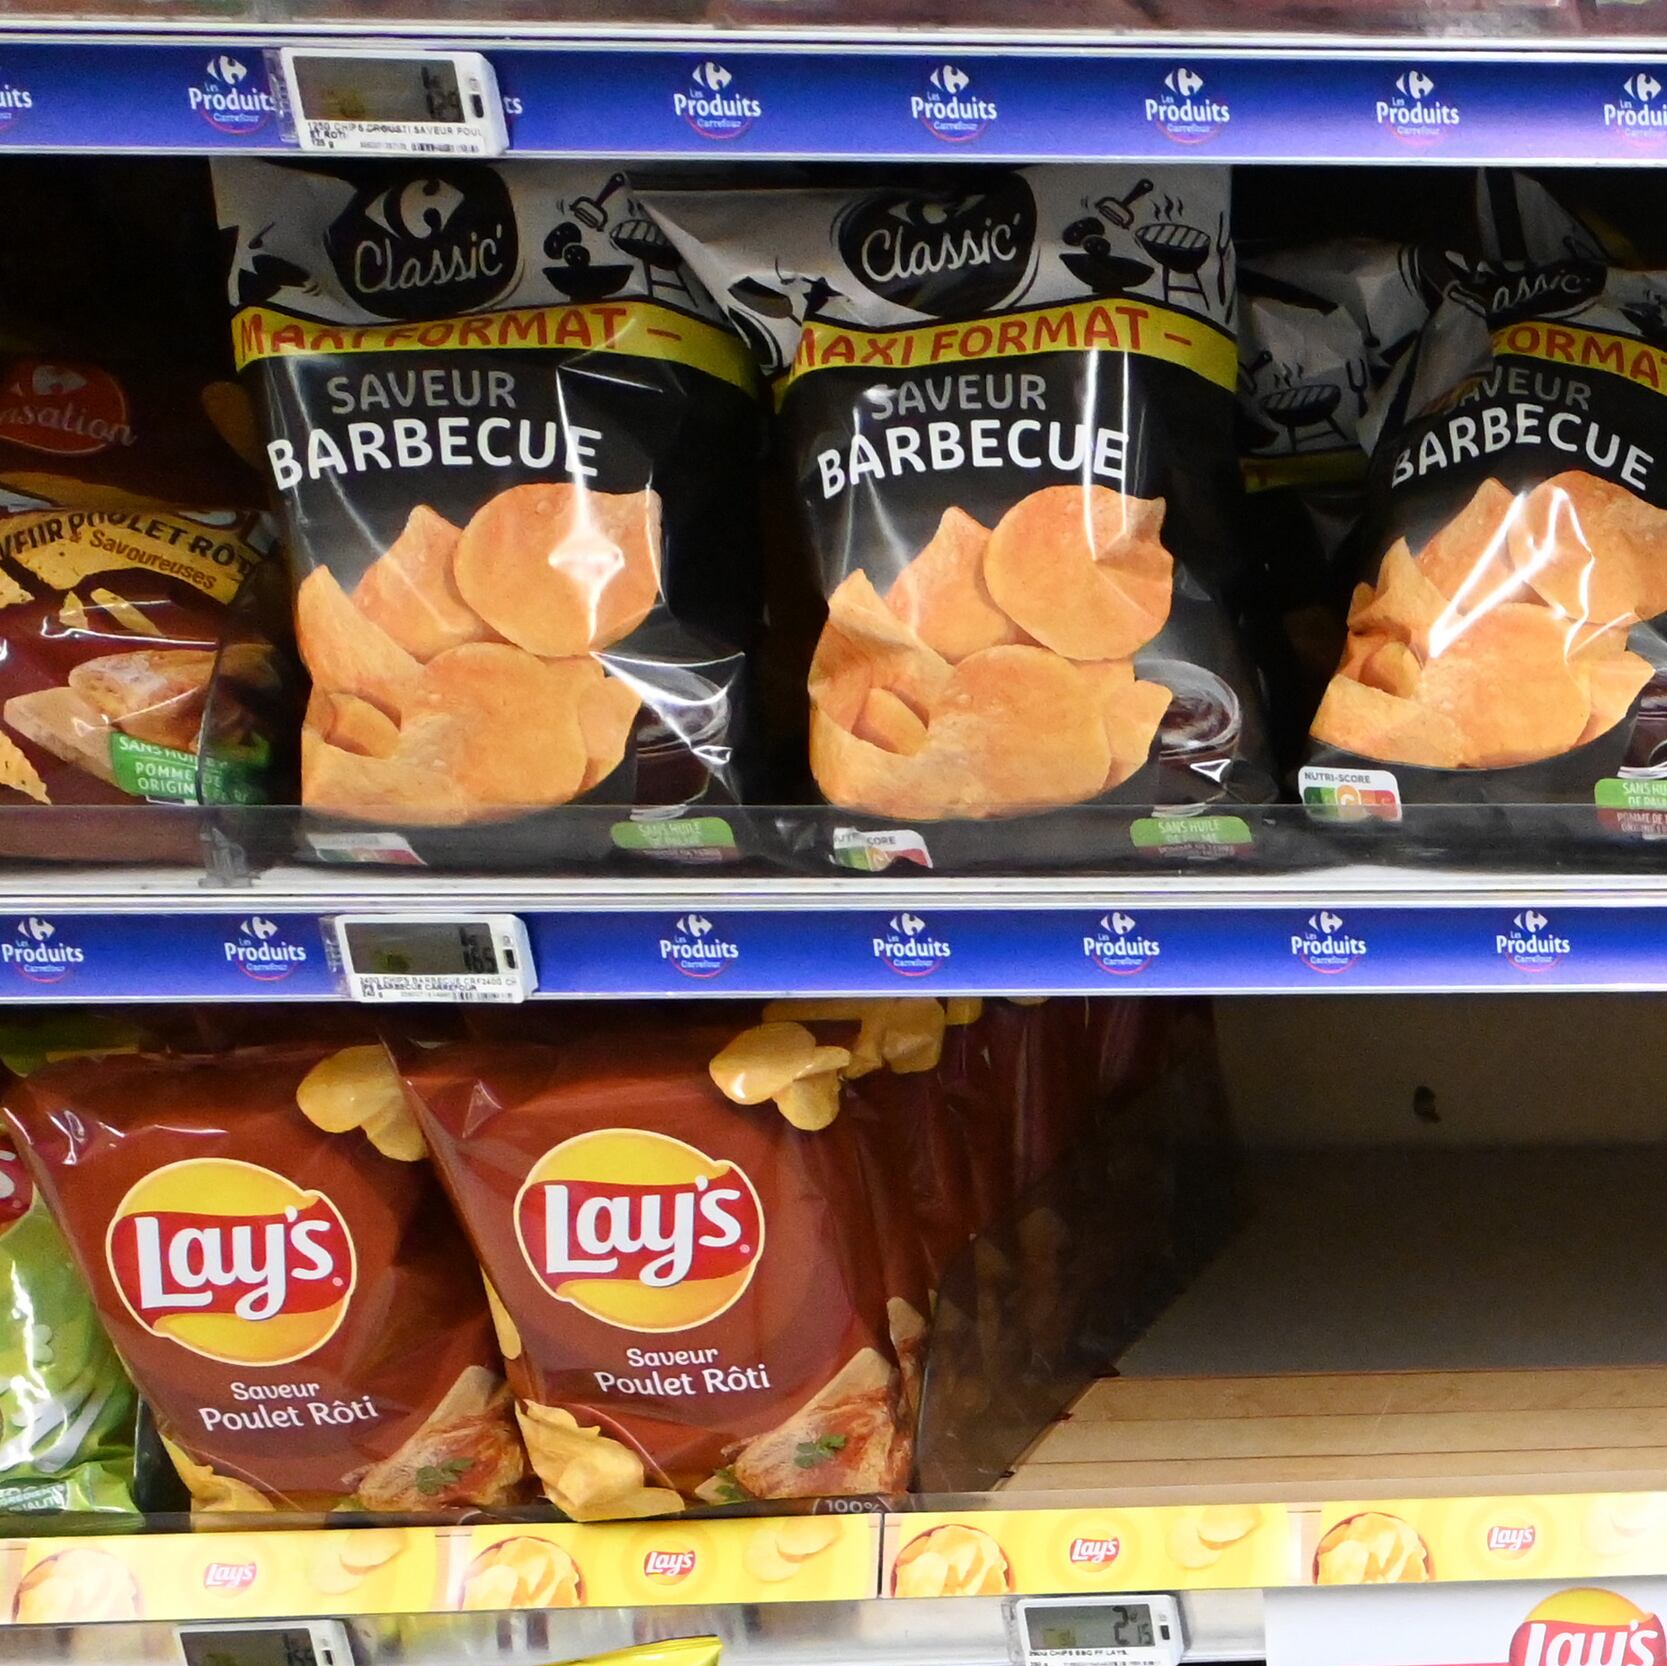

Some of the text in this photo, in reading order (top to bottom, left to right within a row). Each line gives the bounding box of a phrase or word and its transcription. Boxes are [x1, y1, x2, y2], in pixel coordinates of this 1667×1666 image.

[673, 92, 762, 120] Produits
[931, 306, 1148, 361] FORMAT
[328, 370, 517, 414] SAVEUR
[267, 416, 603, 491] BARBECUE
[2, 941, 84, 965] Produits
[543, 1175, 742, 1287] Lay's
[134, 1205, 334, 1321] Lay's
[626, 1346, 719, 1367] Saveur
[231, 1379, 320, 1401] Saveur
[594, 1363, 771, 1397] Poulet Rôti
[200, 1397, 378, 1432] Poulet Rôti
[645, 1550, 694, 1574] Lay's
